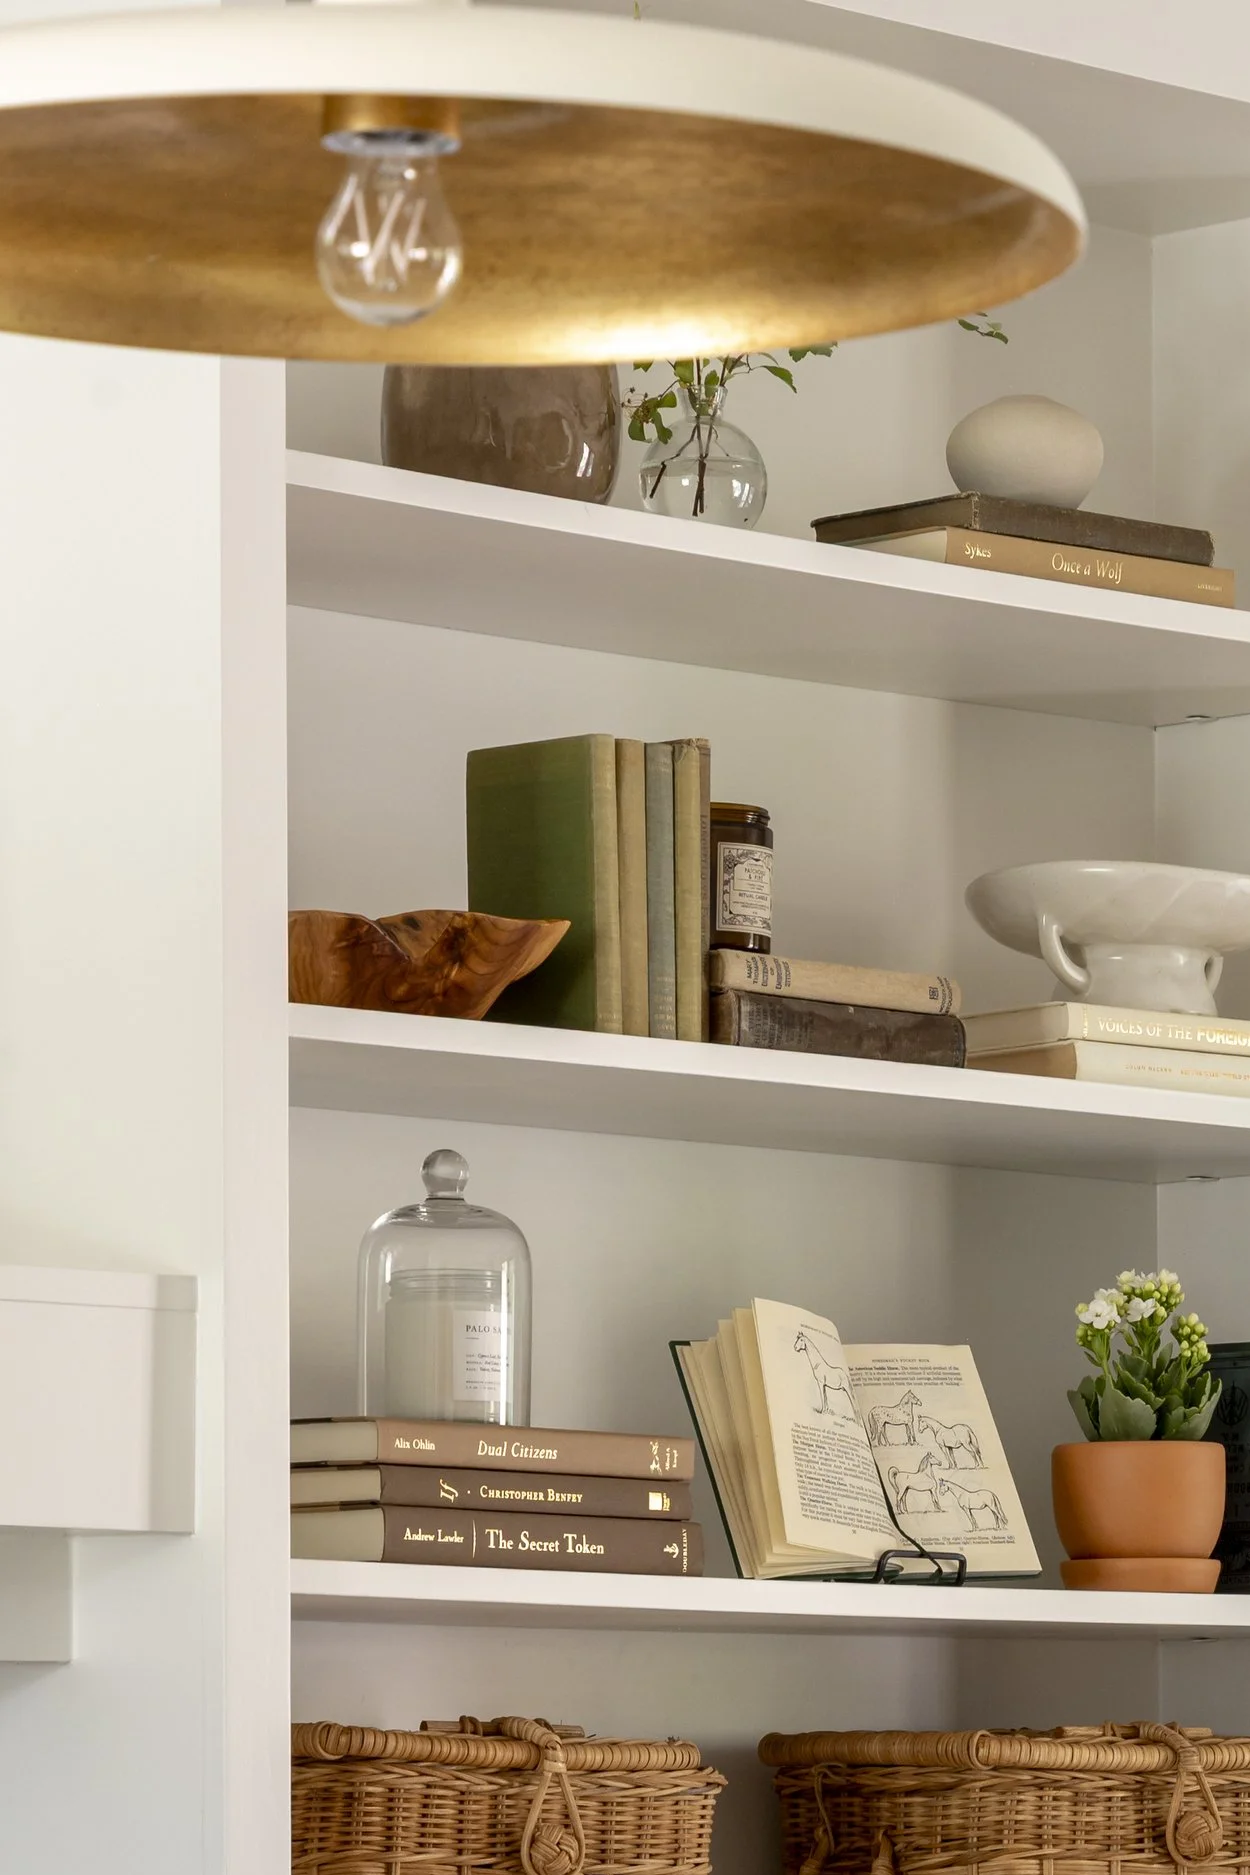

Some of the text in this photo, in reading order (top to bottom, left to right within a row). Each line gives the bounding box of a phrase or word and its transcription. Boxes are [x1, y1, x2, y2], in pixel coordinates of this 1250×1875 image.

[964, 542, 992, 559] Sykes
[1052, 552, 1082, 575] Once
[1096, 559, 1124, 584] Wolf
[745, 959, 753, 979] MARY
[1097, 1016, 1143, 1035] VOICES
[1146, 1021, 1163, 1037] OF
[1166, 1024, 1193, 1040] THE
[465, 1324, 490, 1333] PALO
[394, 1438, 558, 1460] Alix Ohlin Dual Citizens
[439, 1478, 583, 1503] If CHRISTOPHER BENFEY
[403, 1527, 604, 1555] Andrew Lawler The Secret Token
